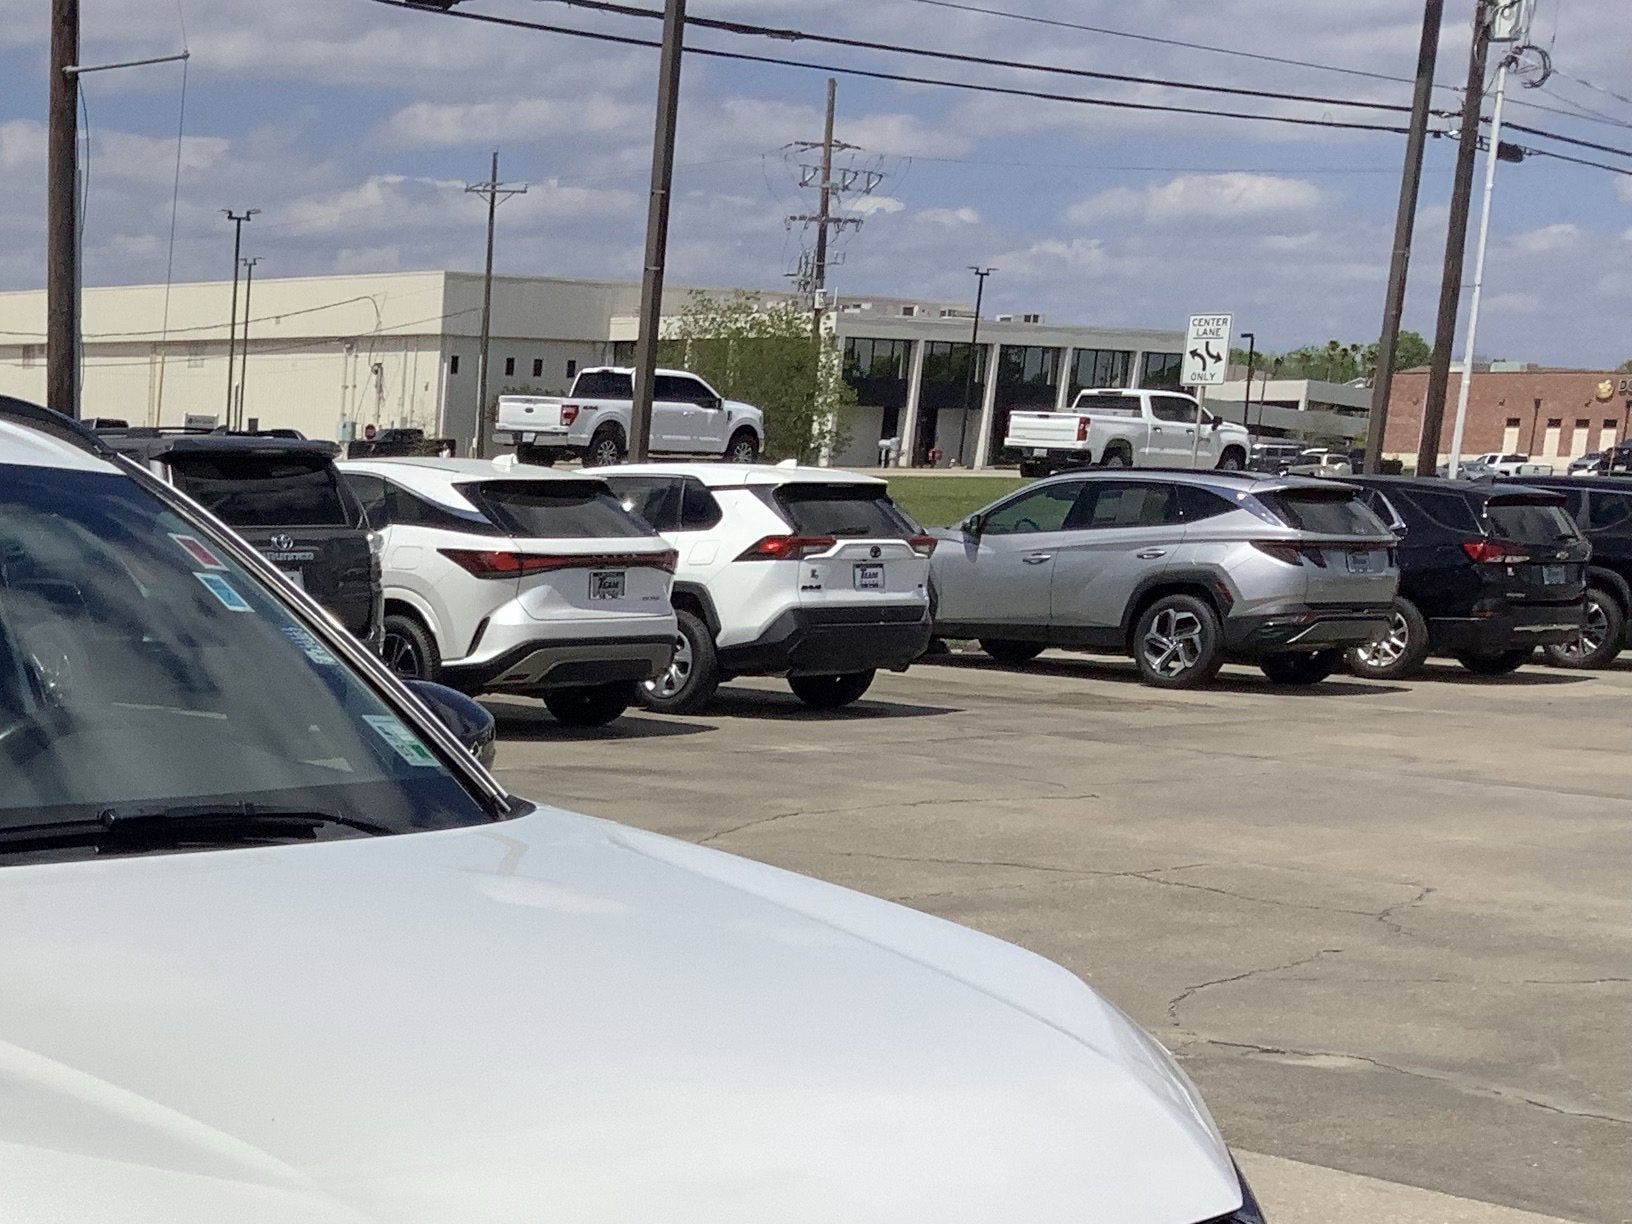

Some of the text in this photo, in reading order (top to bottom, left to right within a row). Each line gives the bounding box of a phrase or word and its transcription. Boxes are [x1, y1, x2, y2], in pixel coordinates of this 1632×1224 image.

[1191, 317, 1229, 327] CENTER
[1196, 327, 1222, 337] LANE
[1190, 372, 1216, 381] ONLY
